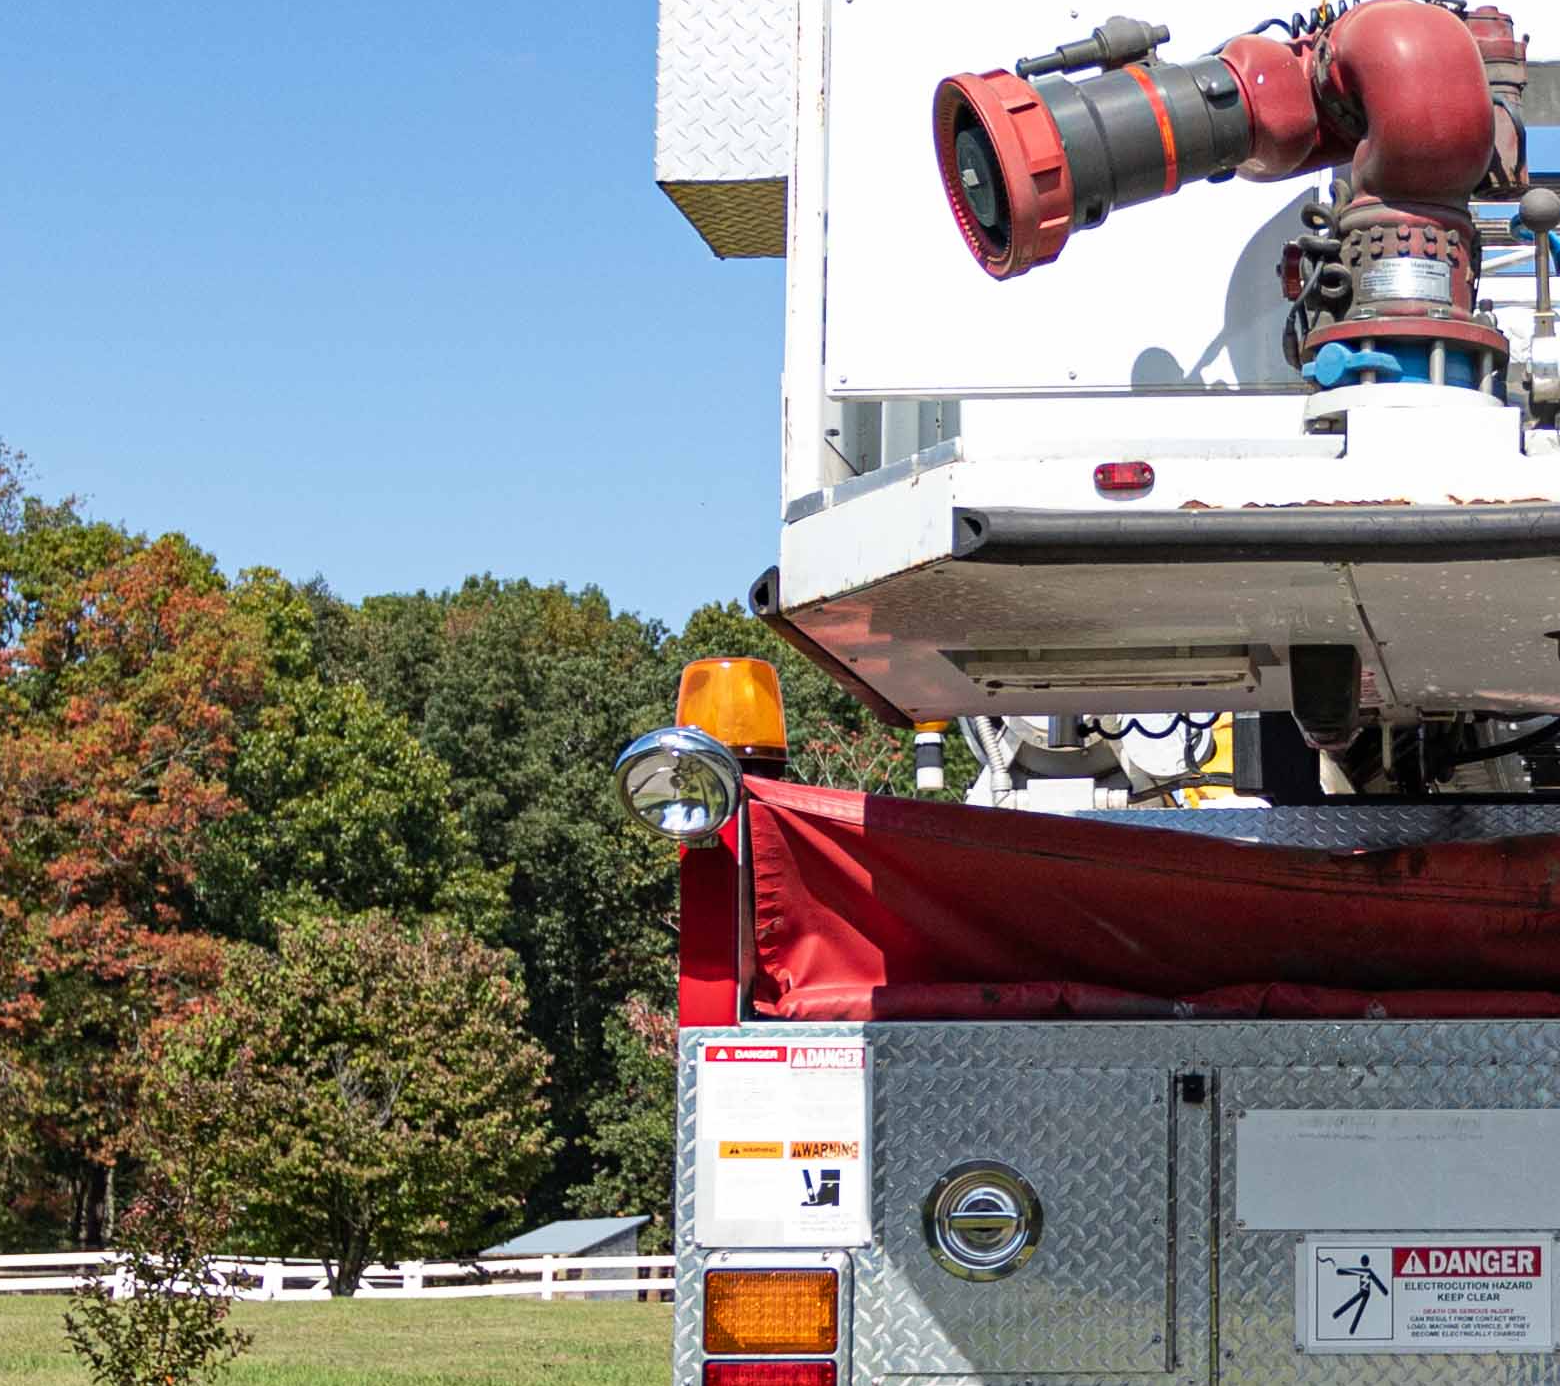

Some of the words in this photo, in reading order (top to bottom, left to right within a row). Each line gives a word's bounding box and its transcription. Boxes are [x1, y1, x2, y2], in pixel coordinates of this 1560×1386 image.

[734, 1049, 778, 1060] DANGER
[806, 1048, 863, 1068] DANGER
[802, 1143, 859, 1158] WARNING
[1429, 1250, 1535, 1274] DANGER
[1404, 1281, 1489, 1291] ELECTROCUTION
[1492, 1281, 1533, 1290] HAZARD
[1437, 1293, 1464, 1301] KEEP
[1467, 1293, 1500, 1301] CLEAR
